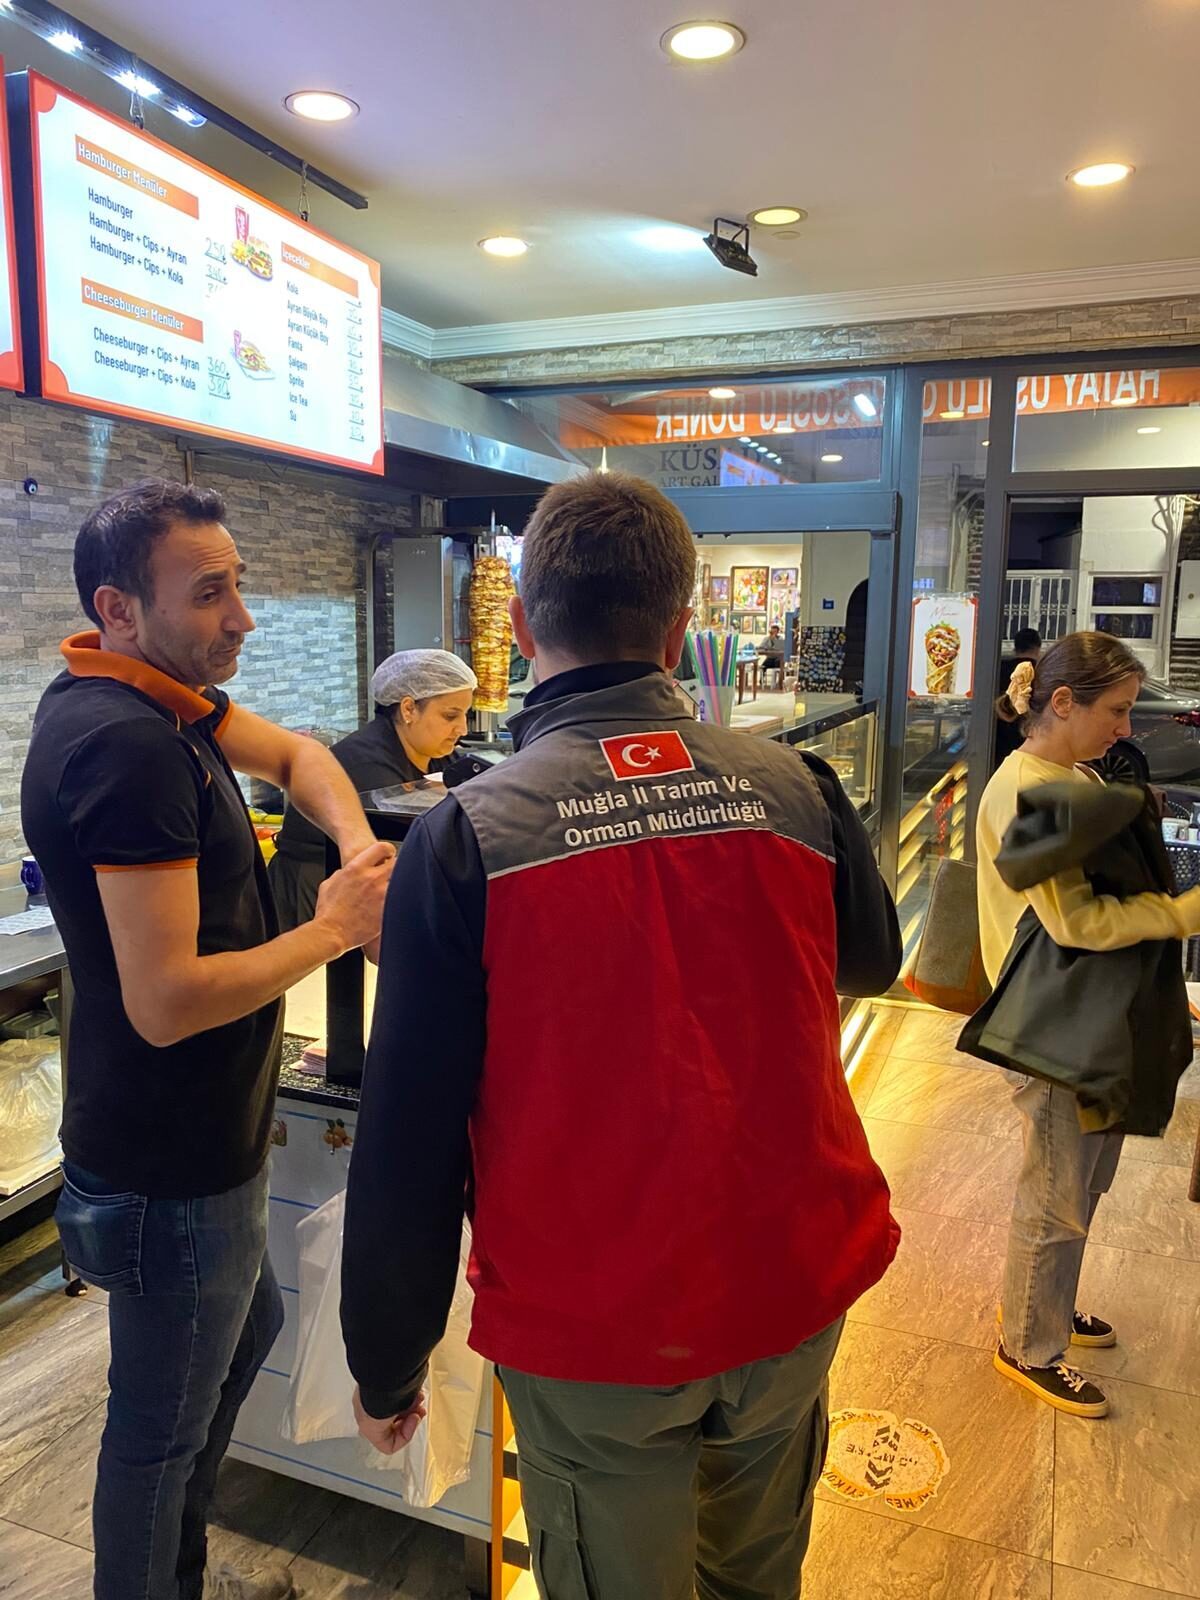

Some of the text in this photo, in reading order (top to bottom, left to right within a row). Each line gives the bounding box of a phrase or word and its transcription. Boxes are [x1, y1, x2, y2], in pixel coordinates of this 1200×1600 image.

[78, 143, 168, 198] Hamburger Menüler
[88, 187, 134, 220] Hamburger
[90, 212, 134, 242] Hamburger
[166, 246, 188, 266] Ayran
[90, 236, 135, 267] Hamburger
[168, 268, 184, 285] Kola
[286, 280, 299, 295] Kola
[84, 285, 185, 331] Cheeseburger Menüler
[288, 300, 302, 314] Ayran
[288, 318, 302, 333] Ayran
[94, 327, 148, 356] Cheeseburger
[180, 354, 200, 372] Ayran
[288, 336, 303, 352] Fanta
[94, 350, 150, 378] Cheeseburger
[180, 376, 196, 390] Kola
[289, 374, 305, 388] Sprite
[290, 410, 297, 422] Su
[299, 394, 308, 407] Tea
[556, 775, 753, 819] Muğla İl Tarım Ve
[564, 800, 766, 847] Orman Müdürlüğü
